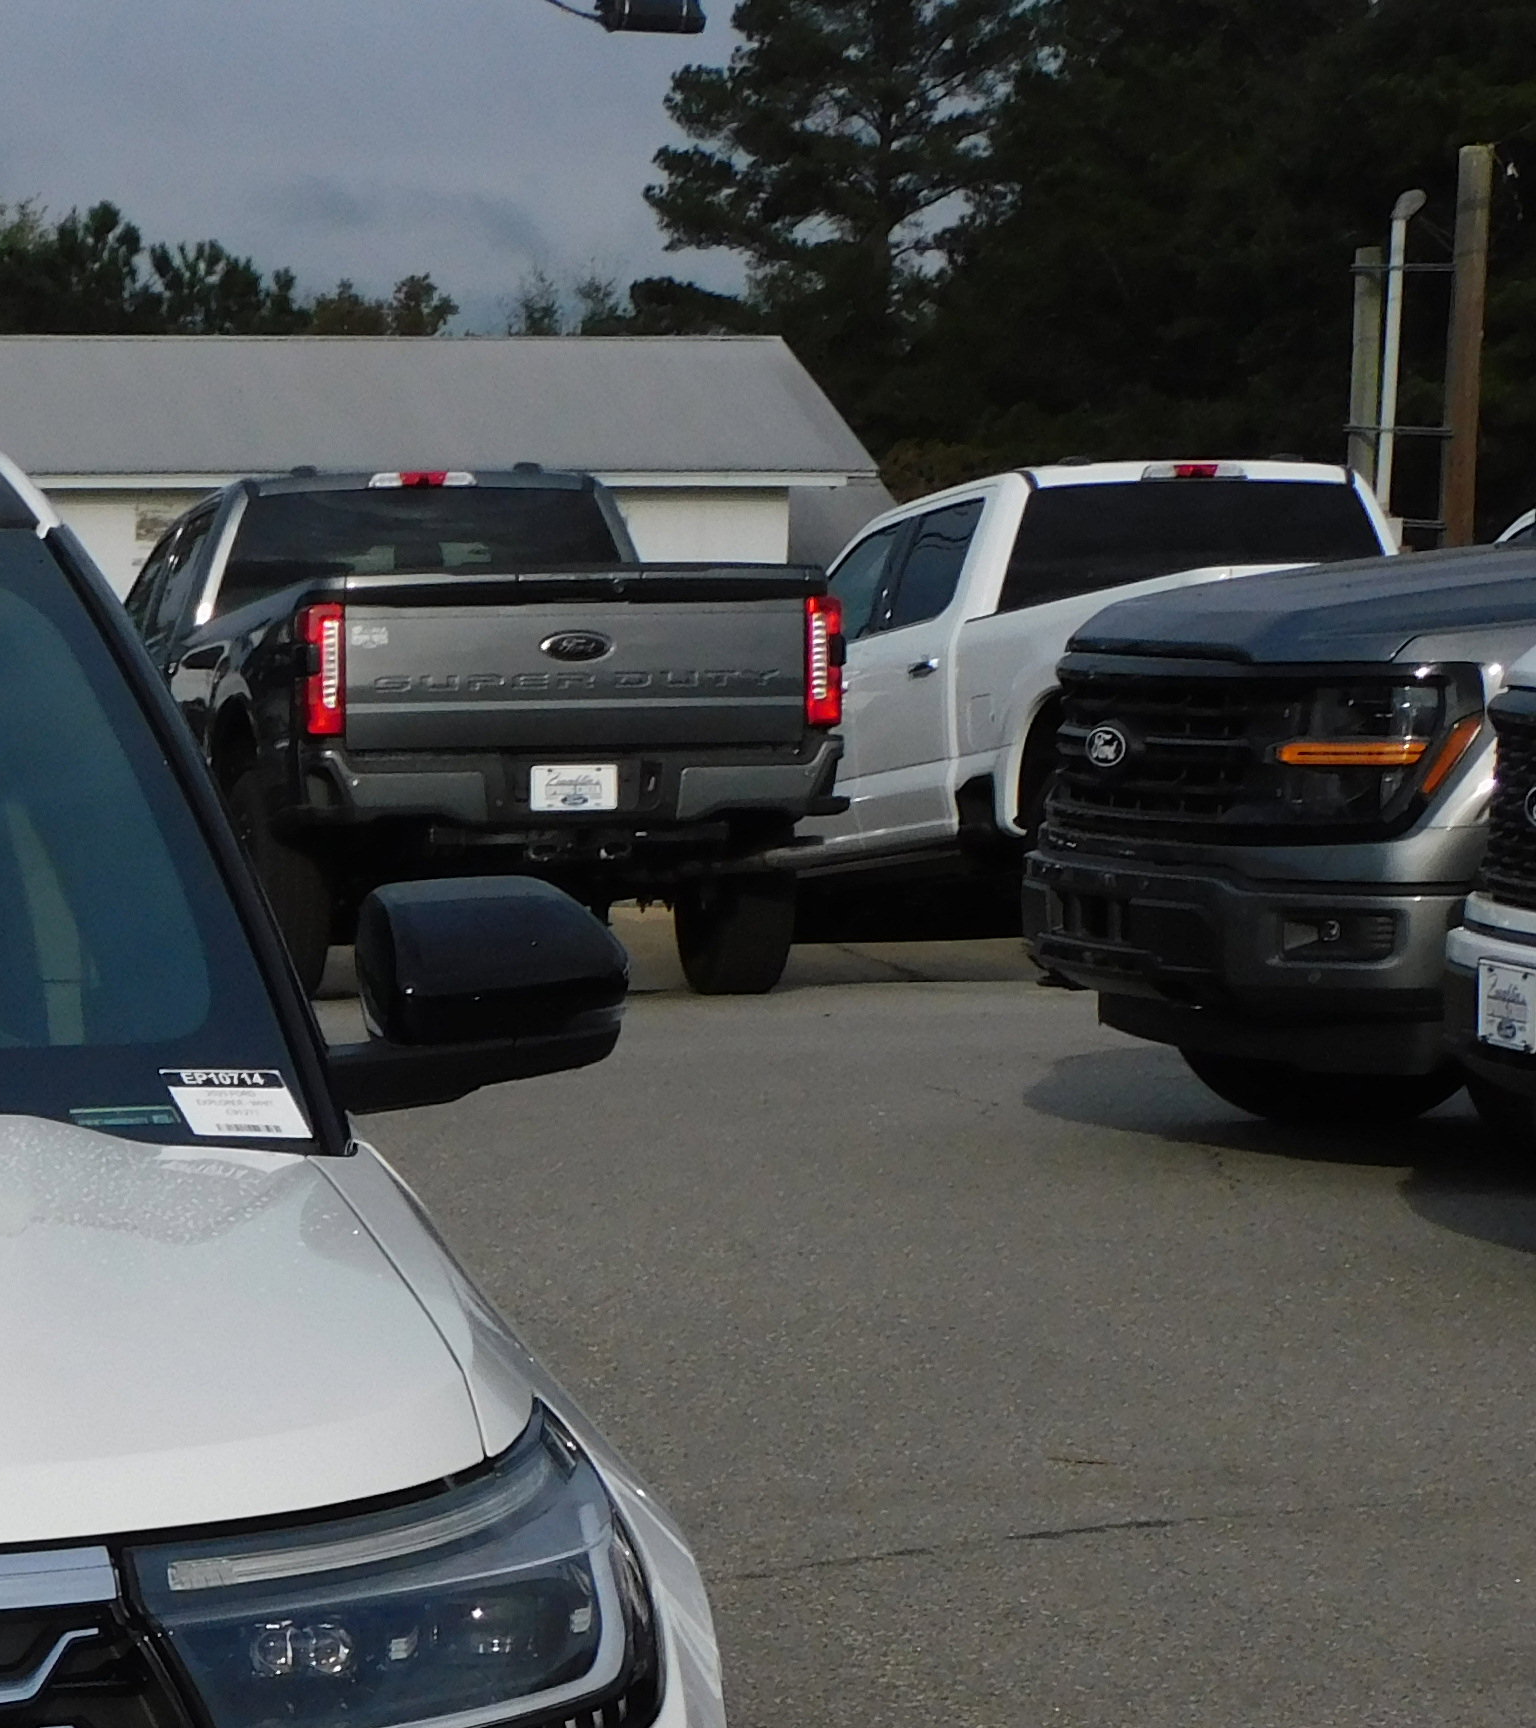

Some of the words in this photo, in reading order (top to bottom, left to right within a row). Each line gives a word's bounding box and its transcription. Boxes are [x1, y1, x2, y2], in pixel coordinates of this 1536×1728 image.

[373, 669, 597, 693] SUPER
[613, 667, 781, 690] DUTY
[179, 1071, 265, 1086] EP10714
